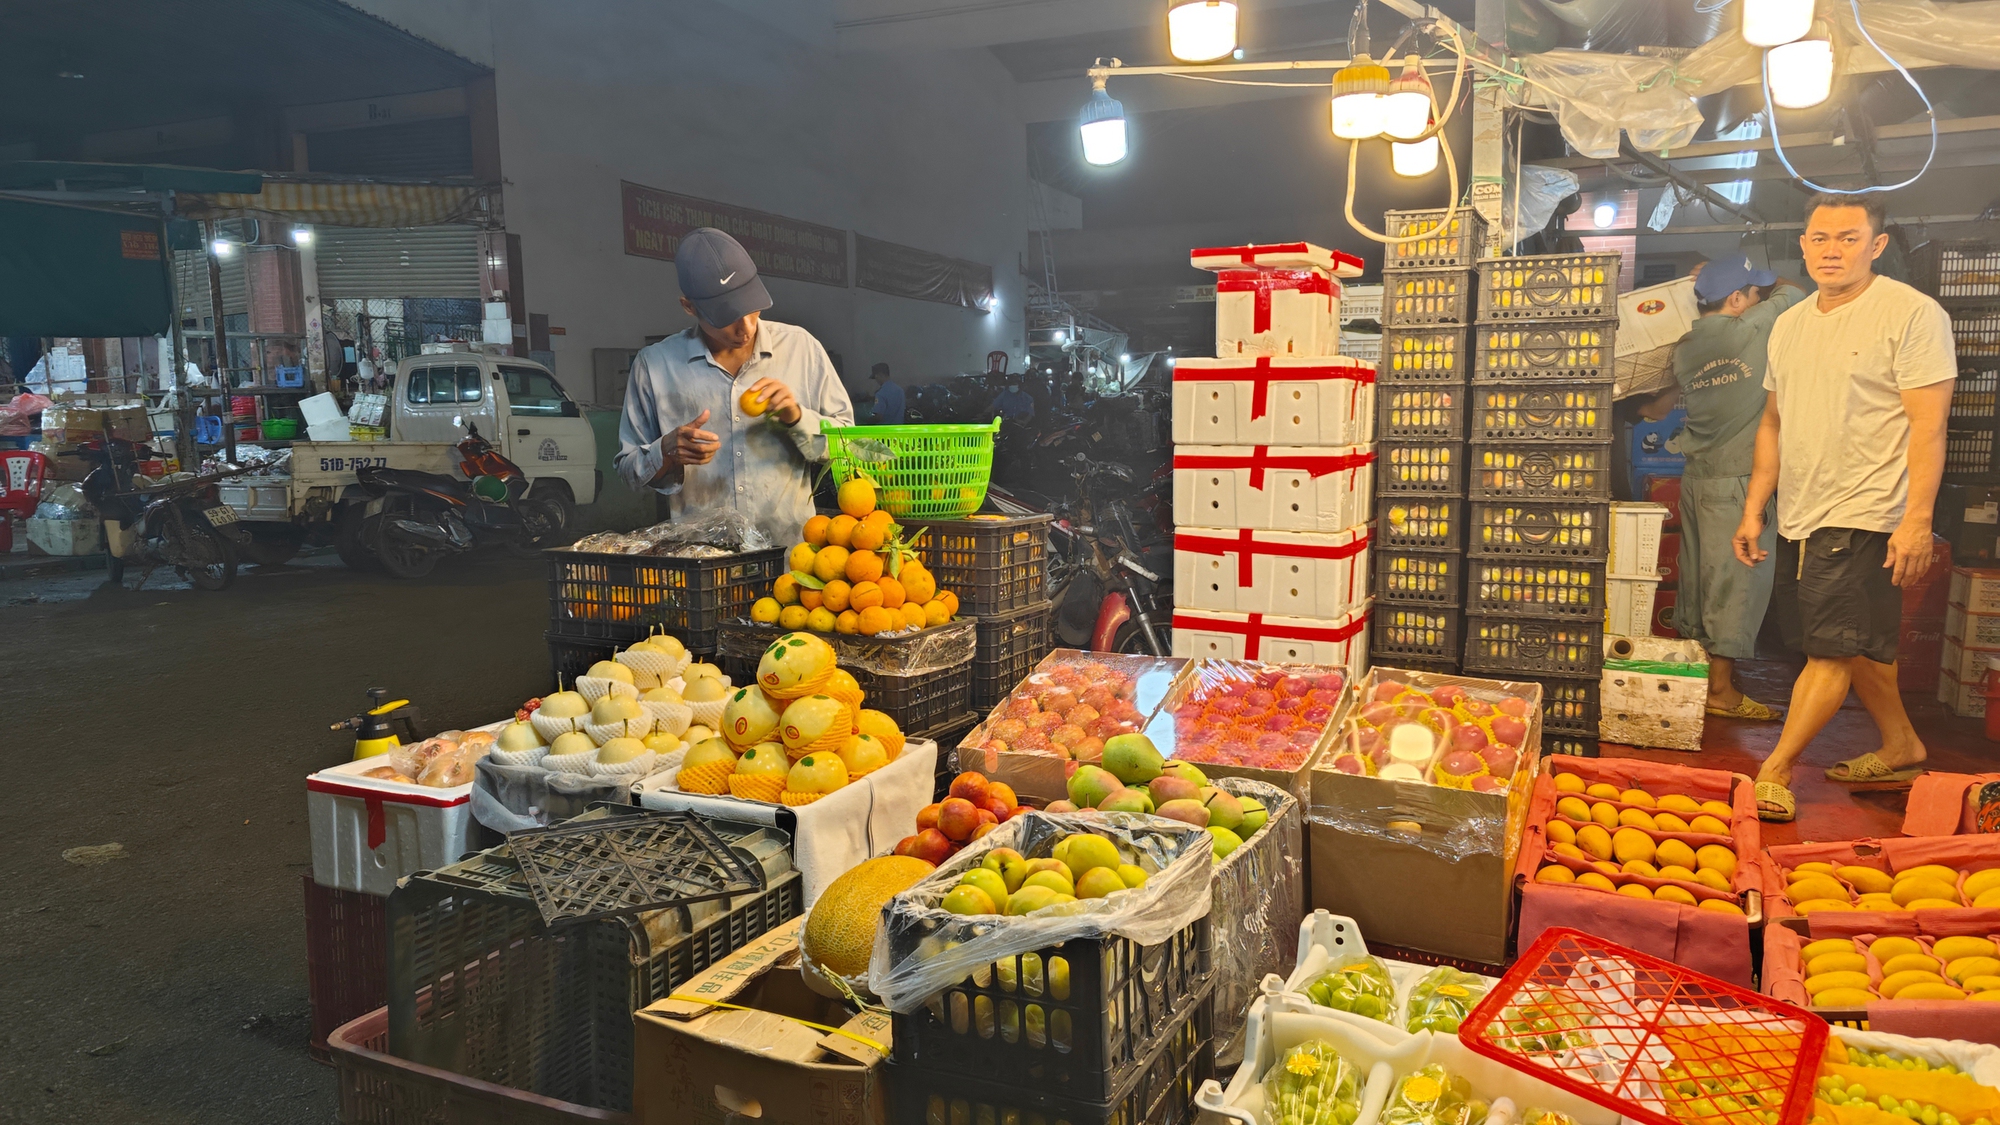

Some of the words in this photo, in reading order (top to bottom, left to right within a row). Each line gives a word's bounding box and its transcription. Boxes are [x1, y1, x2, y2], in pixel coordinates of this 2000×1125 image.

[636, 194, 661, 219] TÍCH
[662, 203, 684, 224] CỰC
[685, 207, 712, 227] THAM
[714, 213, 730, 233] GIA
[732, 214, 750, 236] CÁC
[751, 221, 773, 243] HOẠT
[773, 252, 795, 272] CHỮA
[1691, 378, 1710, 390] HÓC
[1711, 373, 1738, 387] MÔN
[1906, 630, 1941, 642] Fruit
